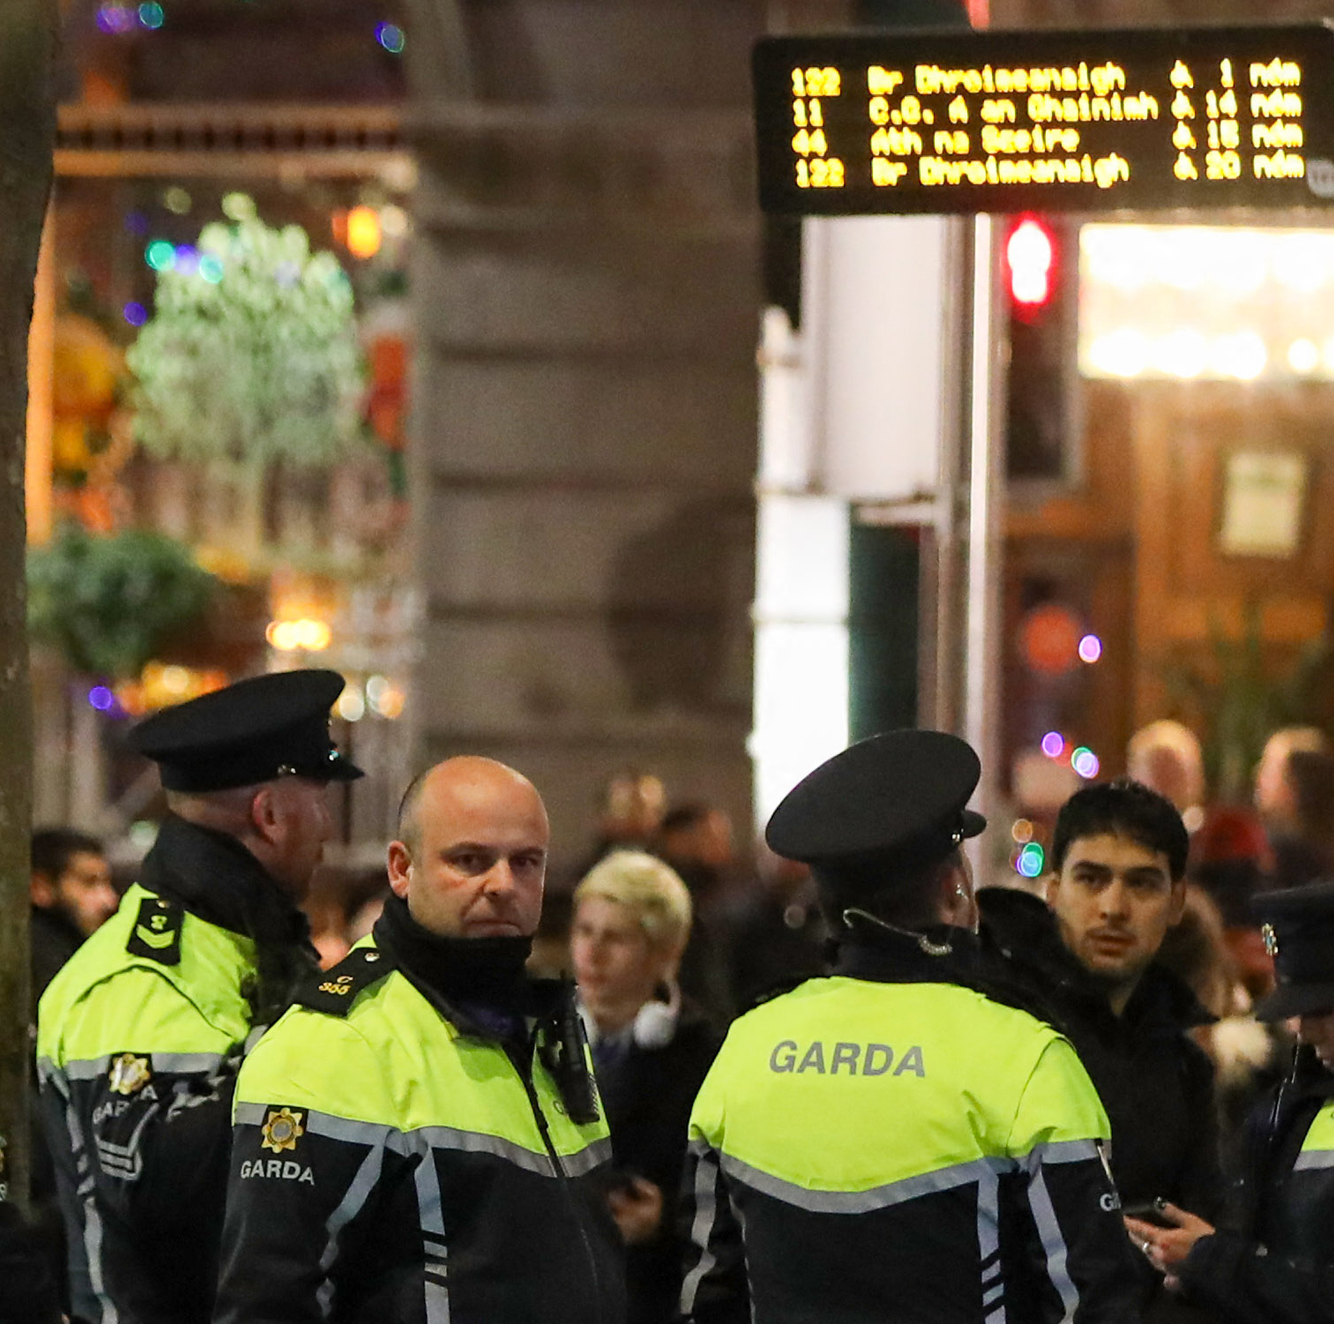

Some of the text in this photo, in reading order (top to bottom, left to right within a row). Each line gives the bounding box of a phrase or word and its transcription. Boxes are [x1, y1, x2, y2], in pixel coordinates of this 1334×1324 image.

[791, 67, 841, 96] 122
[1220, 58, 1234, 88] 1
[793, 98, 823, 127] 11
[1205, 89, 1238, 119] 14
[791, 128, 828, 157] 44
[795, 158, 845, 188] 122
[1205, 149, 1242, 180] 20
[769, 1040, 926, 1078] GARDA
[240, 1159, 315, 1186] GARDA
